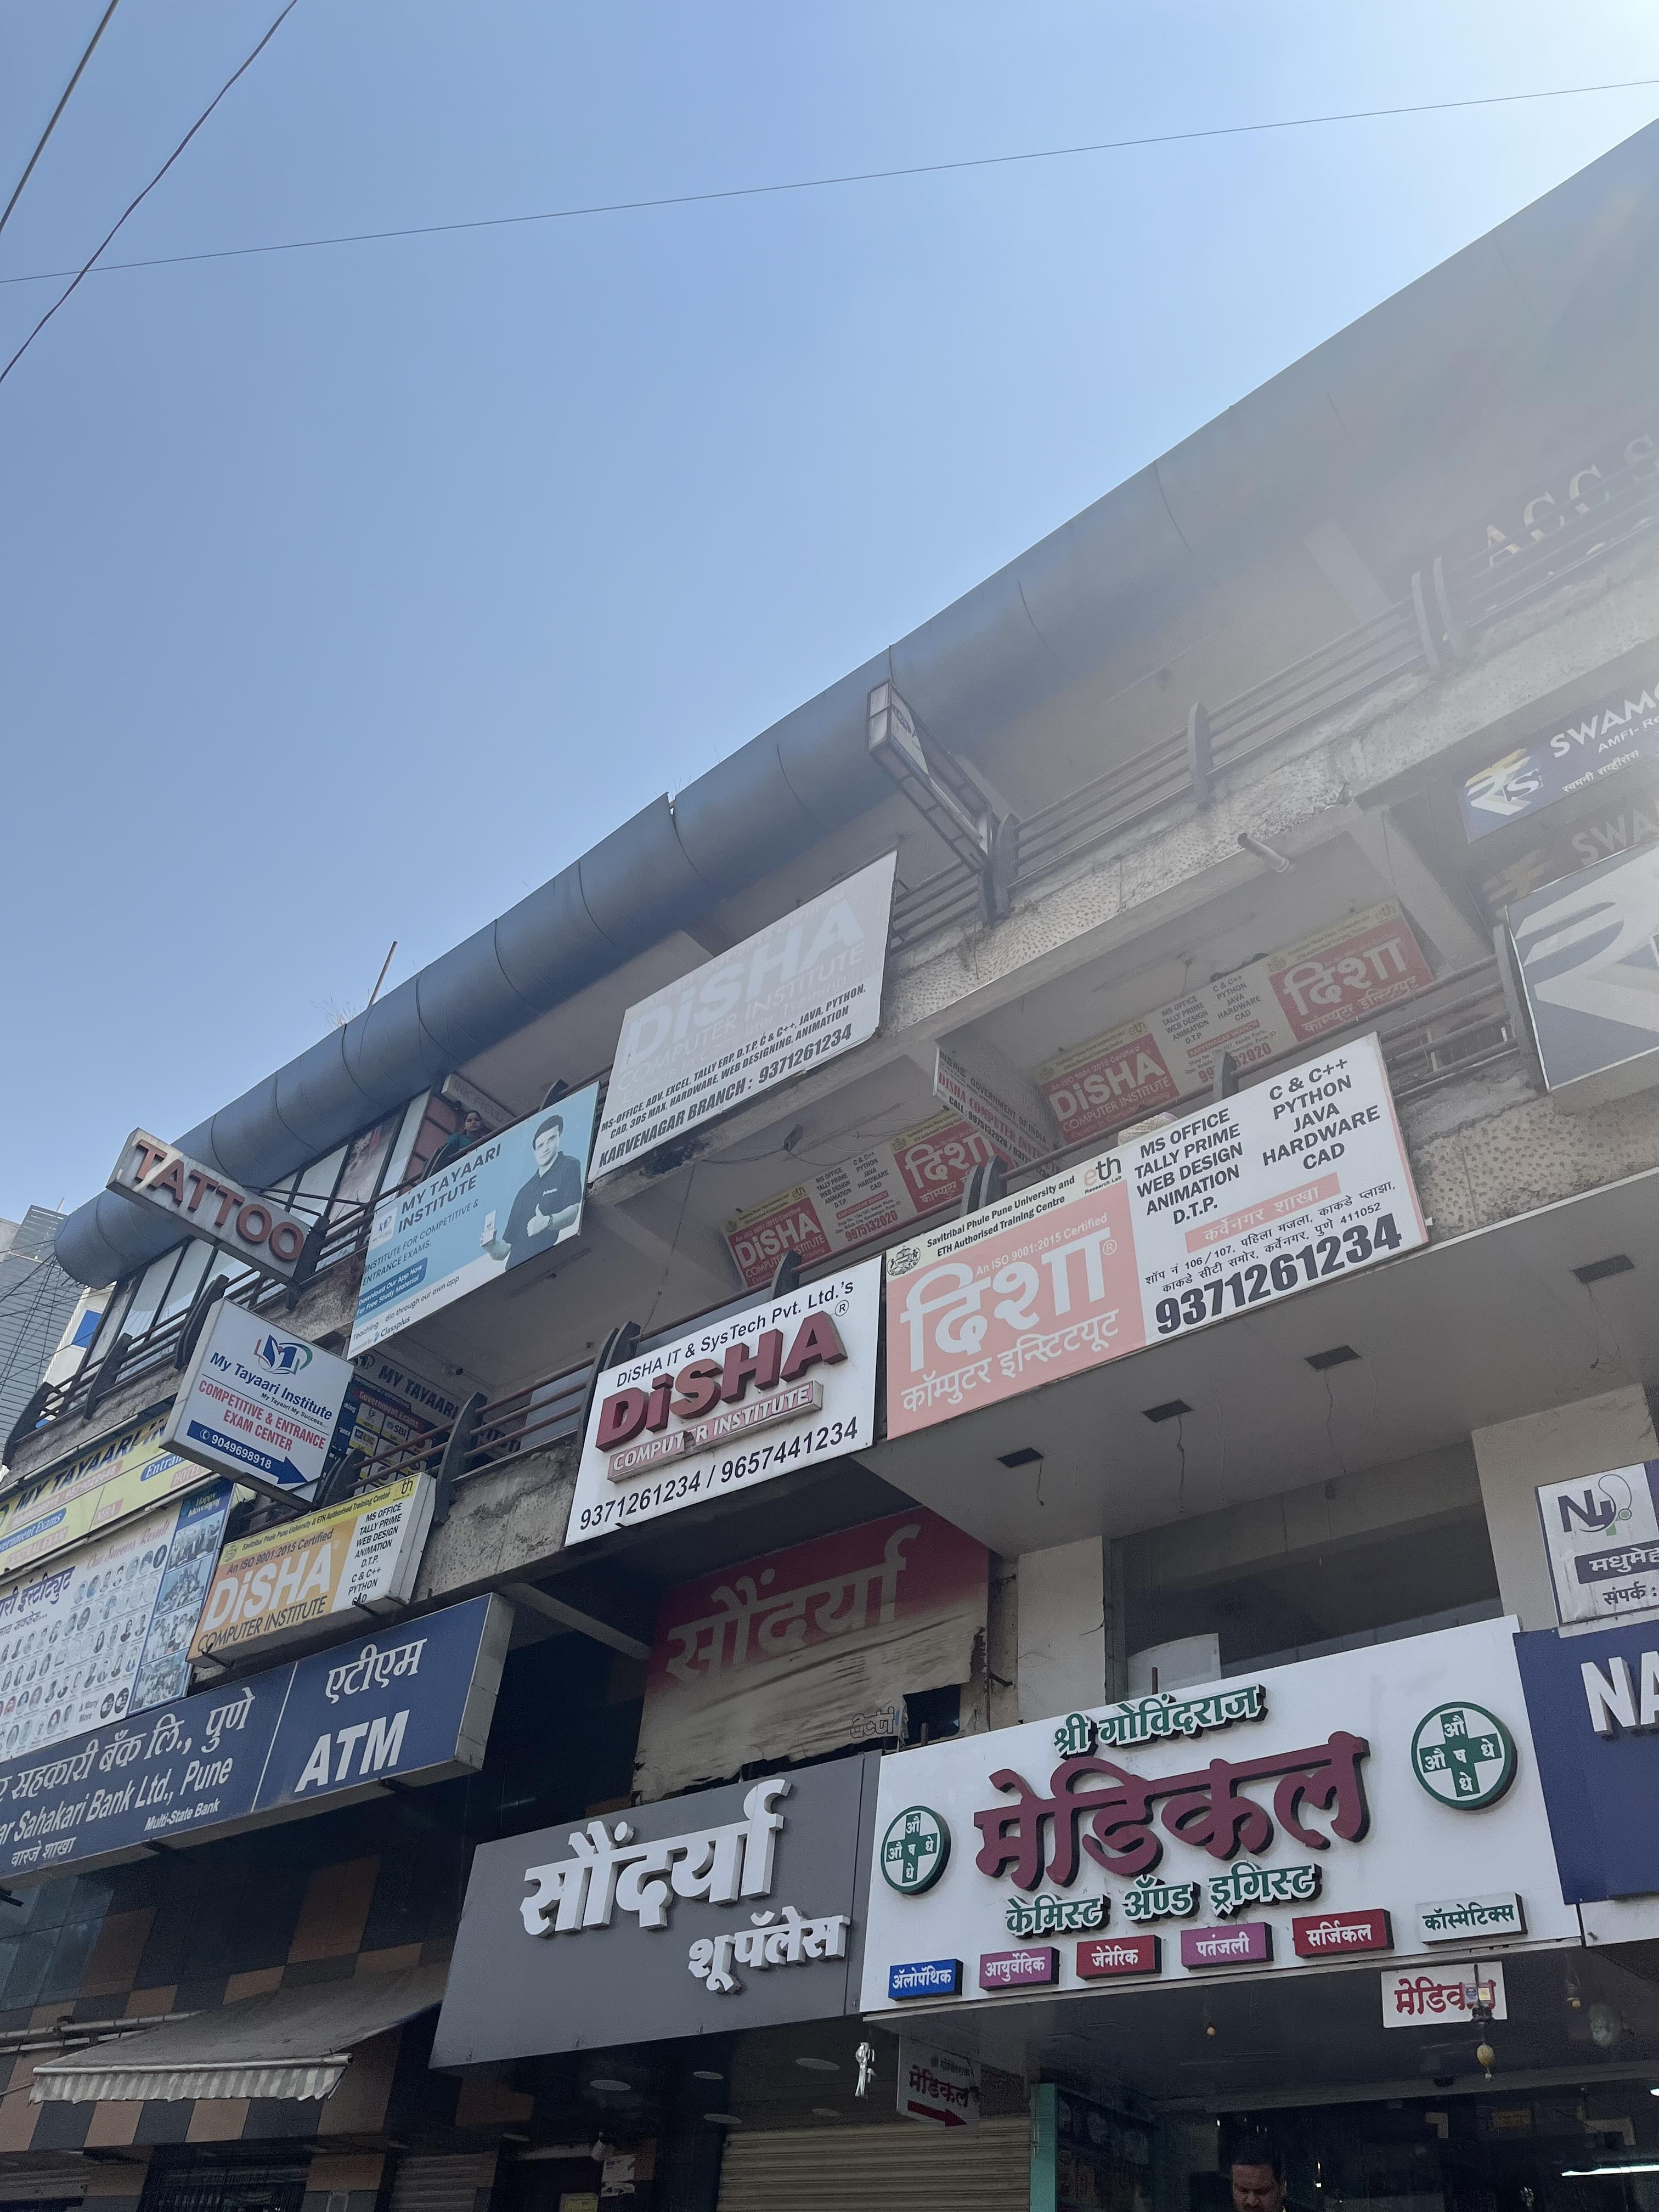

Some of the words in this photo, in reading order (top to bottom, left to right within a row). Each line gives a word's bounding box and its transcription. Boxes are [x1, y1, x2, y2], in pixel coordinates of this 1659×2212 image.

[1216, 982, 1247, 1000] PYTHON
[1283, 936, 1409, 1015] दिशा
[1162, 1014, 1182, 1026] TALLY
[1182, 1002, 1205, 1018] PRIME
[1173, 995, 1198, 1012] OFFICE
[1182, 1009, 1209, 1028] DESIGN
[1217, 996, 1262, 1019] HARDWARE
[1226, 994, 1245, 1007] JAVA
[1172, 1019, 1210, 1042] ANIMATION
[601, 1101, 644, 1132] MS-OFFICE,
[693, 1061, 718, 1082] TALLY
[799, 1006, 824, 1026] JAVA,
[826, 983, 866, 1012] PYTHON,
[669, 1075, 719, 1108] HARDWARE,
[721, 1062, 741, 1081] WEB
[742, 1035, 793, 1069] DESIGNING,
[795, 1005, 849, 1042] ANIMATION
[1308, 1058, 1348, 1082] C++
[599, 1109, 686, 1168] KARVENAGAR
[686, 1076, 747, 1122] BRANCH
[758, 1023, 852, 1085] 9371261234
[939, 1071, 967, 1104] DISHA
[968, 1097, 1016, 1142] COMPUTER
[970, 1077, 1017, 1119] GOVERNMENT
[1049, 1049, 1166, 1122] DiSHA
[1063, 1097, 1120, 1132] COMPUTER
[1118, 1076, 1172, 1114] INSTITUTE
[1273, 1074, 1352, 1120] PYTHON
[1139, 1136, 1165, 1159] MS
[1170, 1108, 1231, 1145] OFFICE
[1262, 1104, 1380, 1166] HARDWARE
[1293, 1102, 1340, 1133] JAVA
[856, 1158, 878, 1172] PYTHON
[864, 1167, 877, 1178] JAVA
[905, 1132, 995, 1189] दिशा
[1083, 1156, 1121, 1188] eth
[1135, 1152, 1179, 1180] TALLY
[1184, 1123, 1241, 1159] PRIME
[1136, 1173, 1176, 1198] WEB
[1180, 1142, 1243, 1177] DESIGN
[1303, 1142, 1345, 1170] CAD
[401, 1188, 426, 1216] MY
[430, 1143, 501, 1196] TAYAARI
[825, 1166, 843, 1180] OFFICE
[830, 1172, 848, 1186] PRIME
[831, 1180, 851, 1194] DESIGN
[857, 1170, 890, 1188] HARDWARE
[1146, 1164, 1240, 1216] ANIMATION
[136, 1139, 304, 1261] TATTOO
[397, 1175, 478, 1233] INSTITUTE
[825, 1187, 852, 1205] ANIMATION
[927, 1226, 966, 1248] Savitribai
[966, 1213, 991, 1235] Phule
[991, 1204, 1013, 1223] Pune
[1014, 1183, 1057, 1210] University
[1058, 1175, 1076, 1190] and
[1173, 1197, 1218, 1225] D.T.P.
[1274, 1185, 1319, 1214] शाखा
[1340, 1201, 1381, 1224] 411052
[364, 1245, 401, 1274] INSTITUTE
[419, 1206, 471, 1241] COMPETITIVE
[733, 1211, 821, 1269] DiSHA
[844, 1210, 899, 1242] 9975132020
[937, 1244, 952, 1258] ETH
[953, 1224, 999, 1250] Authorised
[1000, 1207, 1035, 1233] Training
[1036, 1195, 1066, 1215] Centre
[991, 1255, 1009, 1271] ISO
[1011, 1232, 1062, 1262] 9001:2015
[1063, 1211, 1108, 1240] Certified
[1240, 1227, 1272, 1247] पहिला
[362, 1255, 400, 1287] ENTRANCE
[394, 1276, 420, 1297] Material
[1155, 1212, 1402, 1335] 9371261234
[358, 1283, 386, 1307] Download
[395, 1296, 421, 1318] through
[900, 1227, 1111, 1373] दिशा
[380, 1316, 411, 1338] Classplus
[617, 1356, 663, 1388] DiSHA
[667, 1347, 682, 1366] IT
[699, 1316, 766, 1353] SysTech
[771, 1301, 802, 1324] Pvt.
[210, 1351, 232, 1372] My
[234, 1362, 281, 1395] Tayaari
[281, 1387, 332, 1420] Institute
[377, 1364, 404, 1387] MY
[404, 1378, 460, 1420] TAYAARI
[595, 1310, 848, 1453] DiSHA
[199, 1380, 264, 1420] COMPETITIVE
[275, 1417, 326, 1449] ENTRANCE
[223, 1409, 254, 1434] EXAM
[255, 1424, 293, 1452] CENTER
[713, 1384, 811, 1437] INSTITUTE
[211, 1434, 272, 1470] 9049698918
[580, 1470, 701, 1531] 9371261234
[721, 1416, 857, 1482] 9657441234
[14, 1480, 45, 1514] MY
[377, 1502, 403, 1519] OFFICE
[35, 1511, 63, 1533] Exams
[357, 1537, 371, 1549] WEB
[372, 1526, 399, 1542] DESIGN
[359, 1522, 379, 1536] TALLY
[380, 1513, 403, 1529] PRIME
[239, 1557, 256, 1572] ISO
[298, 1528, 334, 1550] Certified
[354, 1538, 393, 1559] ANIMATION
[202, 1541, 333, 1634] DiSHA
[347, 1578, 379, 1596] PYTHON
[667, 1524, 922, 1683] सौंदर्या
[1602, 1581, 1646, 1606] संपर्क
[198, 1615, 263, 1652] COMPUTER
[264, 1595, 328, 1631] INSTITUTE
[325, 1638, 427, 1704] एटीएम
[1054, 1711, 1096, 1759] श्री
[1097, 1684, 1267, 1748] गोविंदराज
[11, 1738, 100, 1800] सहकारी
[201, 1686, 256, 1754] पुणे
[294, 1709, 410, 1793] ATM
[13, 1791, 89, 1842] Sahakari
[86, 1780, 137, 1823] Bank
[134, 1768, 174, 1808] Ltd.,
[179, 1757, 233, 1796] Pune
[144, 1807, 194, 1832] Multi-State
[194, 1797, 221, 1820] Bank
[973, 1731, 1372, 1891] मेडिकल
[10, 1839, 42, 1867] वारजे
[42, 1836, 77, 1859] शाखा
[519, 1779, 792, 1938] सौंदर्या
[1005, 1893, 1111, 1939] केमिस्ट
[1208, 1859, 1322, 1920] ड्रगिस्ट
[1423, 1905, 1515, 1932] कॉस्मेटिक्स
[1195, 1932, 1250, 1960] पतंजली
[1306, 1920, 1372, 1949] सर्जिकल
[984, 1951, 1046, 1982] आयुर्वेदिक
[1091, 1944, 1139, 1968] जेनेरिक
